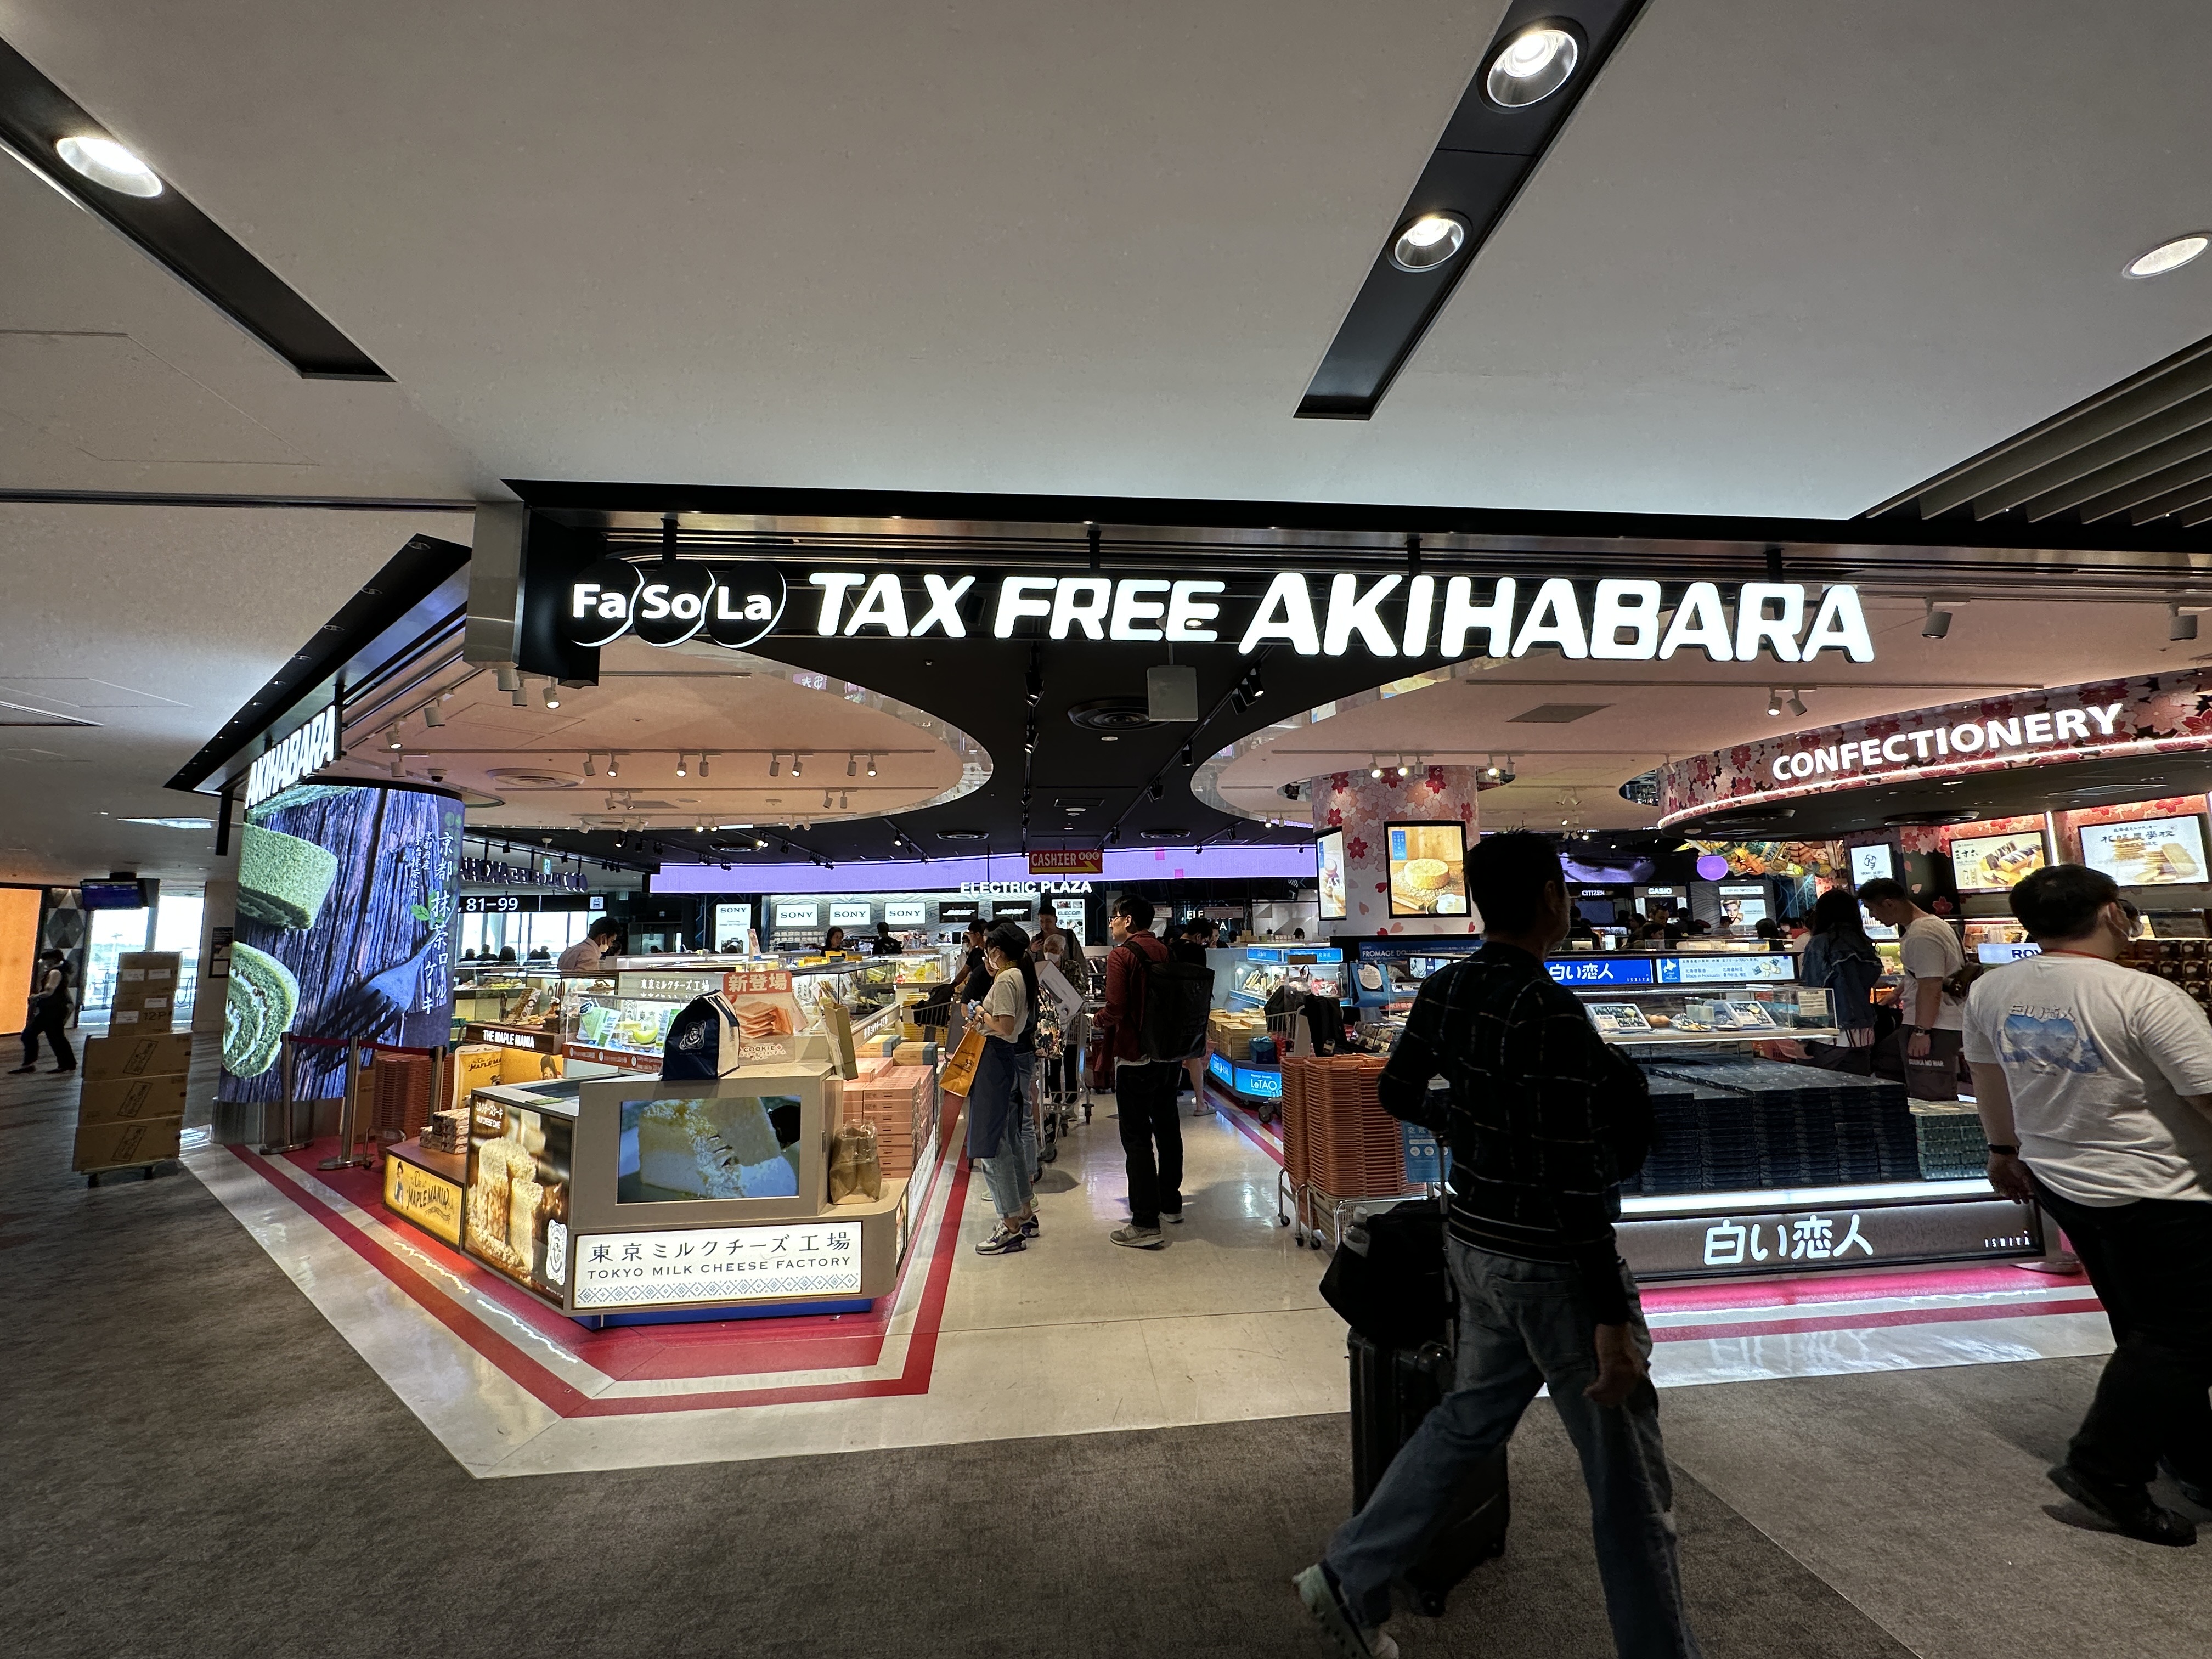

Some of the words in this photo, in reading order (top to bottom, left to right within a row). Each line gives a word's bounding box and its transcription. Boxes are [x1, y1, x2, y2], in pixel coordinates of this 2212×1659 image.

[809, 573, 975, 637] TAX
[994, 577, 1226, 641] FREE
[1238, 571, 1874, 663] AKIHABARA
[1772, 703, 2123, 781] CONFECTIONERY
[245, 705, 335, 809] AKIHABARA
[1031, 853, 1076, 866] CASHIER
[961, 882, 1036, 894] ELECTRIC
[1041, 881, 1092, 894] PLAZA
[427, 831, 454, 999] 京都抹茶ロール
[728, 973, 787, 992] 新登場
[1549, 963, 1613, 980] 白い恋人
[422, 961, 437, 1014] ケーキ
[641, 979, 710, 991] 東京ミルクチーズ工場
[483, 1029, 494, 1042] THE
[494, 1031, 515, 1045] MAPLE
[515, 1034, 535, 1048] MANIA
[1251, 1079, 1277, 1091] LeTAO
[588, 1232, 850, 1263] 東京ミルクチーズ工場
[1703, 1214, 1874, 1265] 白い恋人
[587, 1268, 644, 1279] TOKYO
[652, 1266, 692, 1276] MILK
[701, 1261, 768, 1273] CHEESE
[776, 1256, 850, 1269] FACTORY
